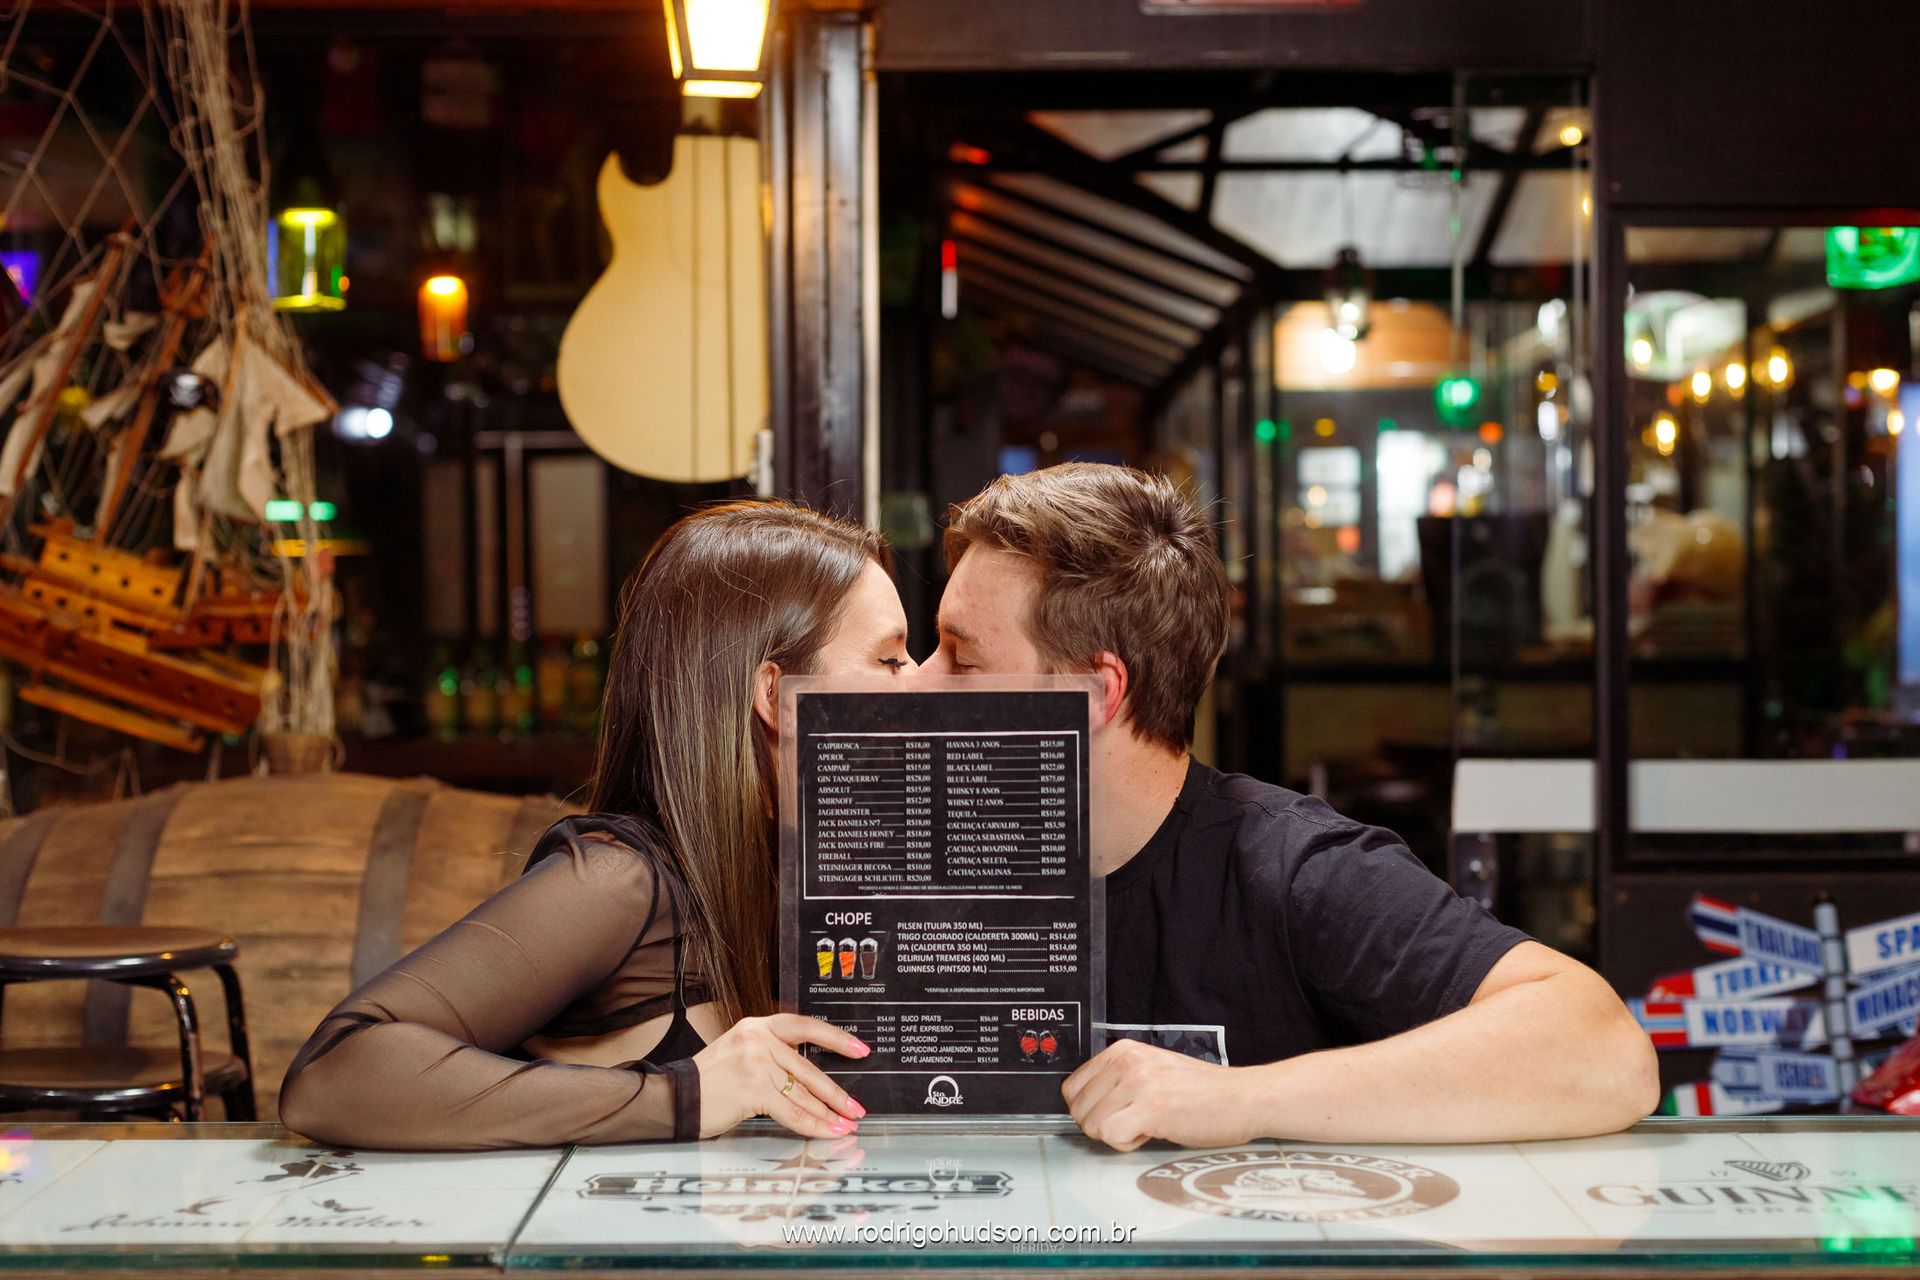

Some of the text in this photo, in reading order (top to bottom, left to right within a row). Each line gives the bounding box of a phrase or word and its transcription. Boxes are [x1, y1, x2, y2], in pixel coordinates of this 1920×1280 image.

[817, 742, 860, 750] CAIPIROSCA
[946, 740, 975, 749] HAVANA
[976, 740, 980, 749] 3
[980, 740, 1000, 749] ANOS
[946, 752, 961, 760] RED
[962, 752, 984, 760] LABEL
[946, 764, 970, 772] BLACK
[972, 764, 994, 772] LABEL
[817, 775, 831, 783] GIN
[833, 775, 880, 783] TANQUERRAY
[817, 786, 851, 794] ABSOLUT
[947, 787, 974, 795] WHISKY
[980, 787, 1000, 795] ANOS
[947, 798, 974, 806] WHISKY
[976, 798, 983, 806] 12
[984, 798, 1004, 806] ANOS
[947, 810, 978, 818] TEQUILA
[946, 822, 981, 830] CACHAÇA
[982, 822, 1020, 830] CARVALHO
[818, 830, 836, 838] JACK
[838, 830, 868, 838] DANIELS
[869, 830, 895, 838] HONEY
[946, 834, 981, 842] CACHAÇA
[947, 845, 981, 854] CACHAÇA
[982, 845, 1018, 854] BOAZINHA
[818, 852, 852, 860] FIREBALL
[947, 856, 981, 865] CACHAÇA
[982, 856, 1008, 865] SELETA
[947, 868, 981, 877] CACHAÇA
[982, 868, 1012, 877] SALINAS
[825, 912, 872, 925] CHOPE
[897, 922, 1077, 930] PILSEN (TULIPA 350 ML) R$9,00
[897, 932, 1077, 941] TRIGO COLORADO (CALDERETA 300ML) R$14,00
[897, 944, 909, 952] IPA
[911, 944, 956, 952] (CALDERETA
[957, 944, 972, 952] 350
[972, 944, 988, 952] ML)
[897, 954, 1078, 962] DELIRIUM TREMENS (400 ML) R$49,00
[897, 965, 935, 973] GUINNESS
[937, 965, 971, 973] (PINT500
[972, 965, 987, 973] ML)
[1011, 1008, 1064, 1020] BEBIDAS
[900, 1056, 918, 1064] CAFÉ
[918, 1056, 953, 1064] JAMENSON
[924, 1094, 964, 1104] ANDRÉ
[1147, 1151, 1435, 1181] PAULANER
[625, 1177, 974, 1194] Heineken
